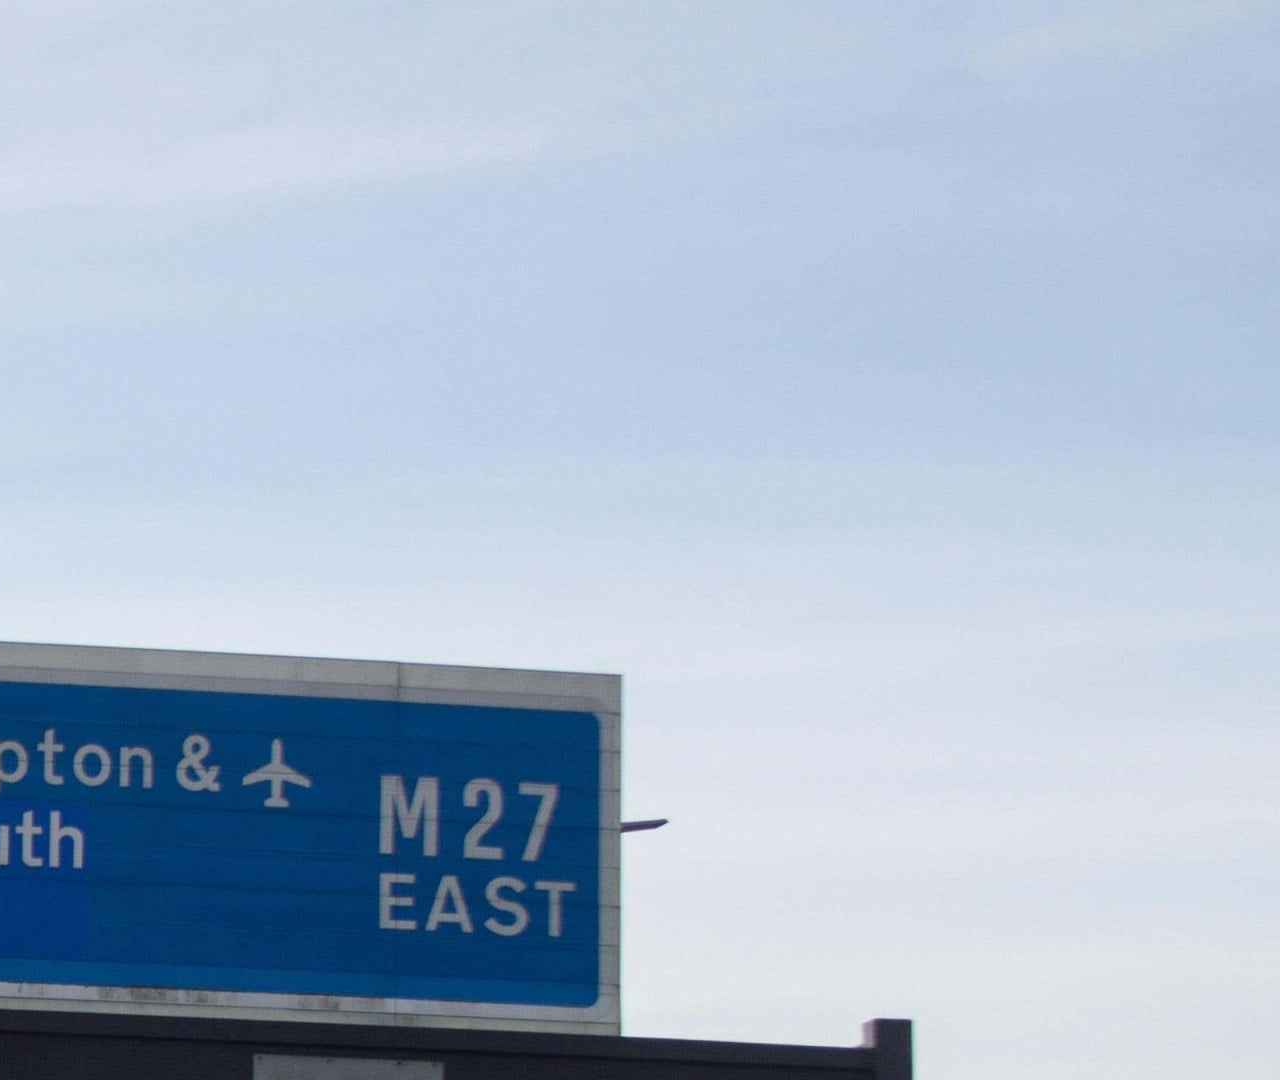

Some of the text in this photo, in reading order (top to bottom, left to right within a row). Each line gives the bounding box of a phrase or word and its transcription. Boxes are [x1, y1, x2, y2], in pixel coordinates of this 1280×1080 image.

[176, 733, 221, 792] &
[379, 774, 560, 862] M27
[379, 872, 577, 937] EAST
